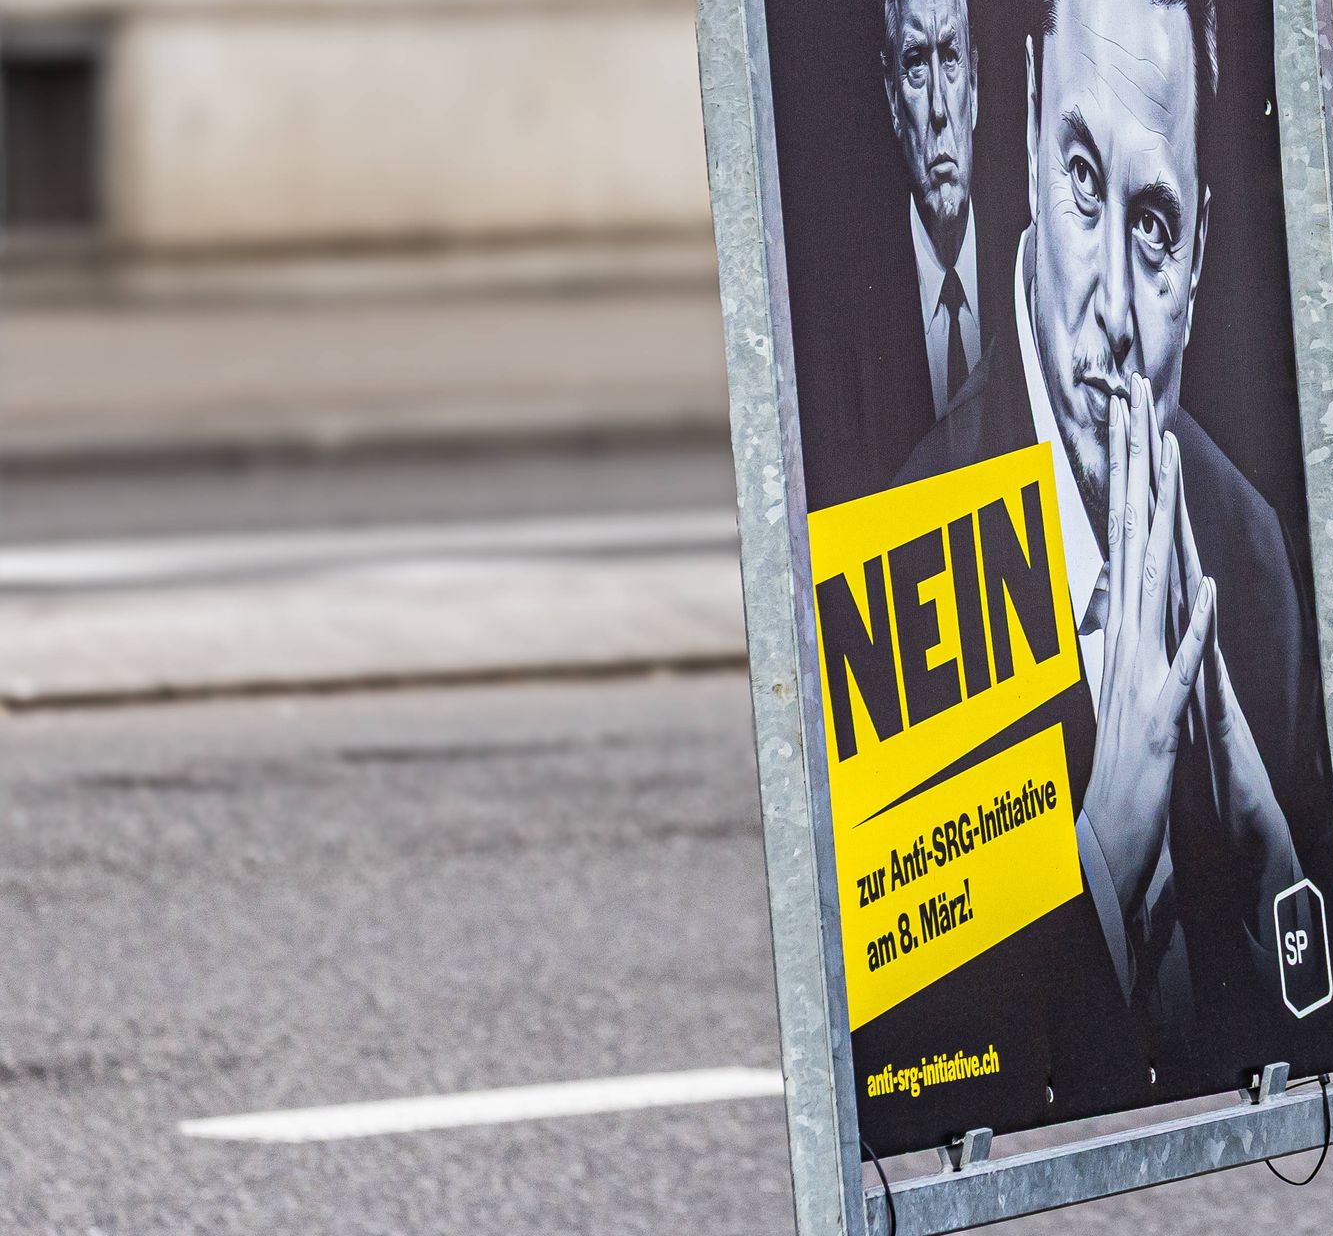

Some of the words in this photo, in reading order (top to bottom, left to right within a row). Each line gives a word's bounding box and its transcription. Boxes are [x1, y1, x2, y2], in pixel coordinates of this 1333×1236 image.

[814, 479, 1063, 764] NEIN
[856, 866, 886, 909] zur
[891, 779, 1057, 892] Anti-SRG-Initiative
[866, 930, 898, 972] am
[897, 912, 919, 954] 8.
[918, 877, 974, 944] März!
[1284, 929, 1309, 966] SP
[867, 1044, 1000, 1097] anti-srg-initiative.ch
